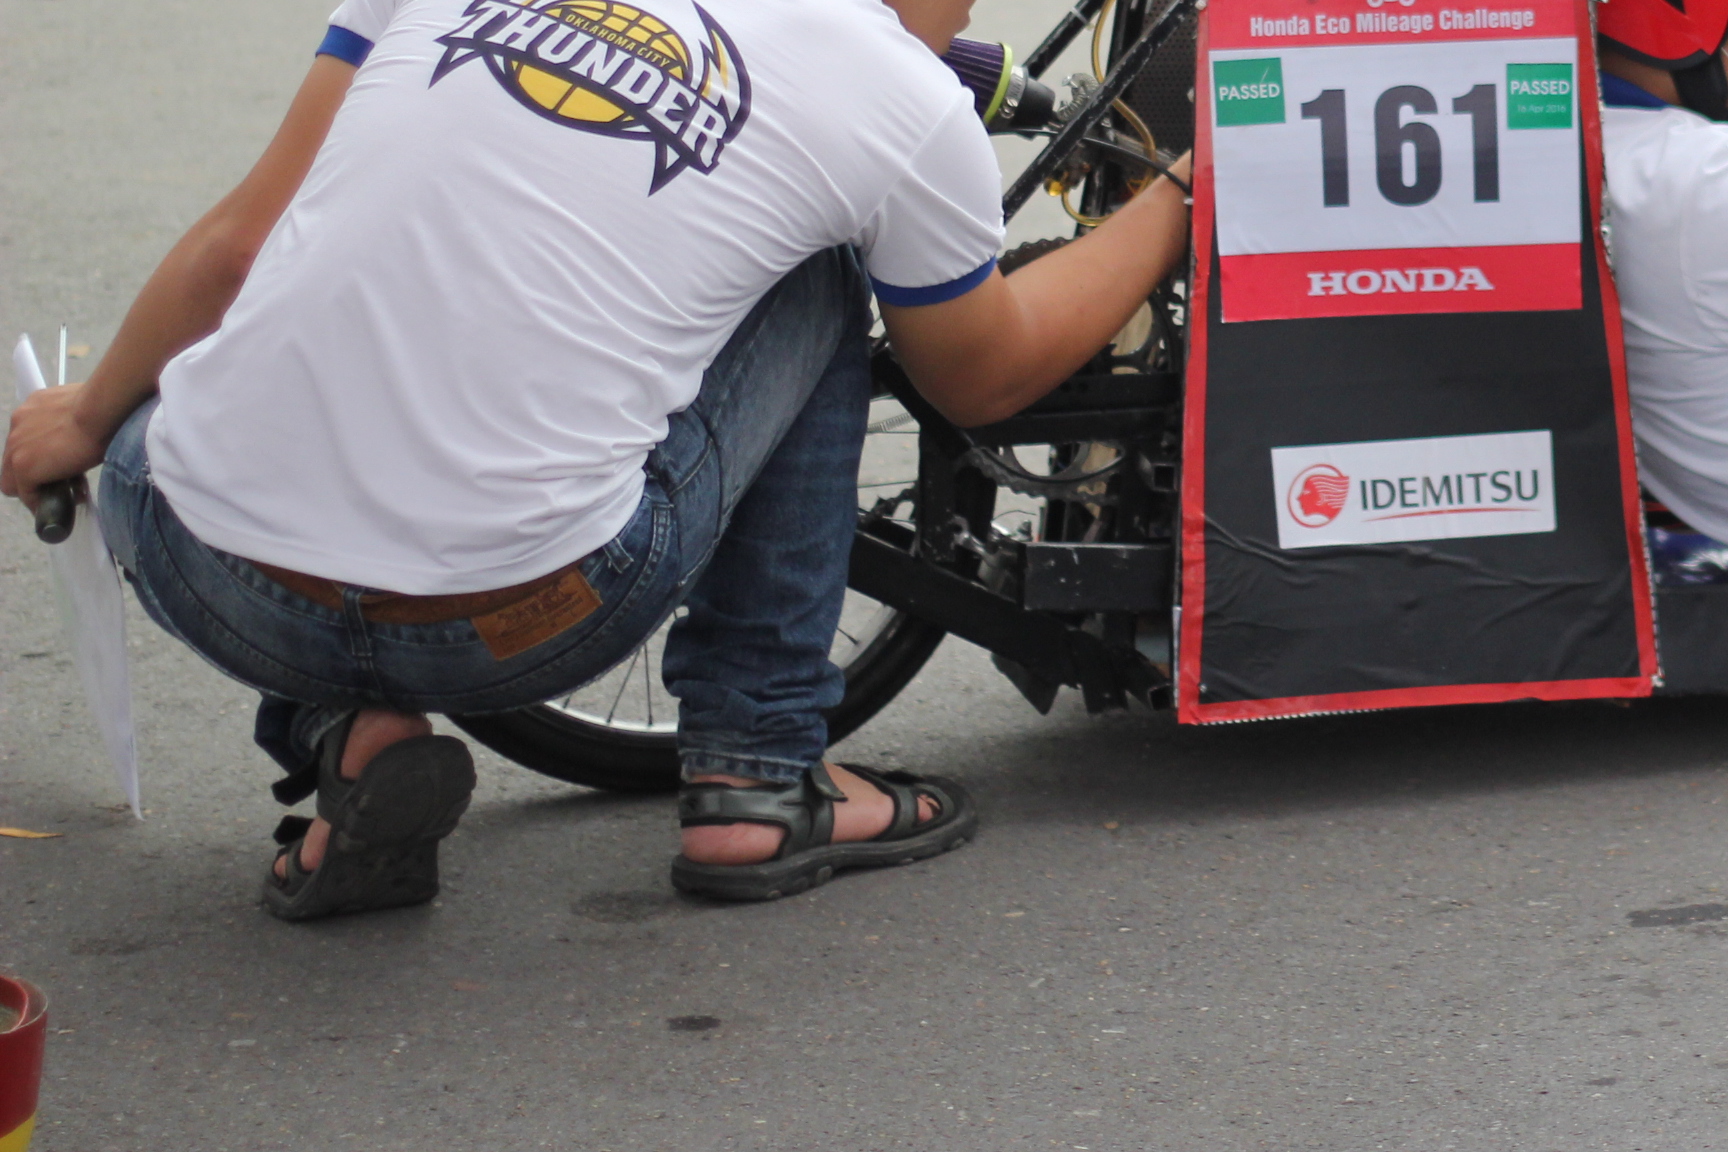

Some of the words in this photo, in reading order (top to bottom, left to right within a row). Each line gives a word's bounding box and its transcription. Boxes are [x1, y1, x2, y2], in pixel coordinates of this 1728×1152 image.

[564, 12, 638, 55] OKLAHOMA
[636, 44, 671, 69] CITY
[1250, 16, 1310, 37] Honda
[1315, 14, 1350, 35] Eco
[1355, 11, 1434, 34] Mileage
[1439, 8, 1535, 31] Challenge
[449, 0, 729, 169] THUNDER
[1218, 82, 1281, 102] PASSED
[1509, 79, 1571, 96] PASSED
[1300, 83, 1500, 208] 161
[1307, 266, 1495, 297] HONDA
[1359, 469, 1540, 511] IDEMITSU
